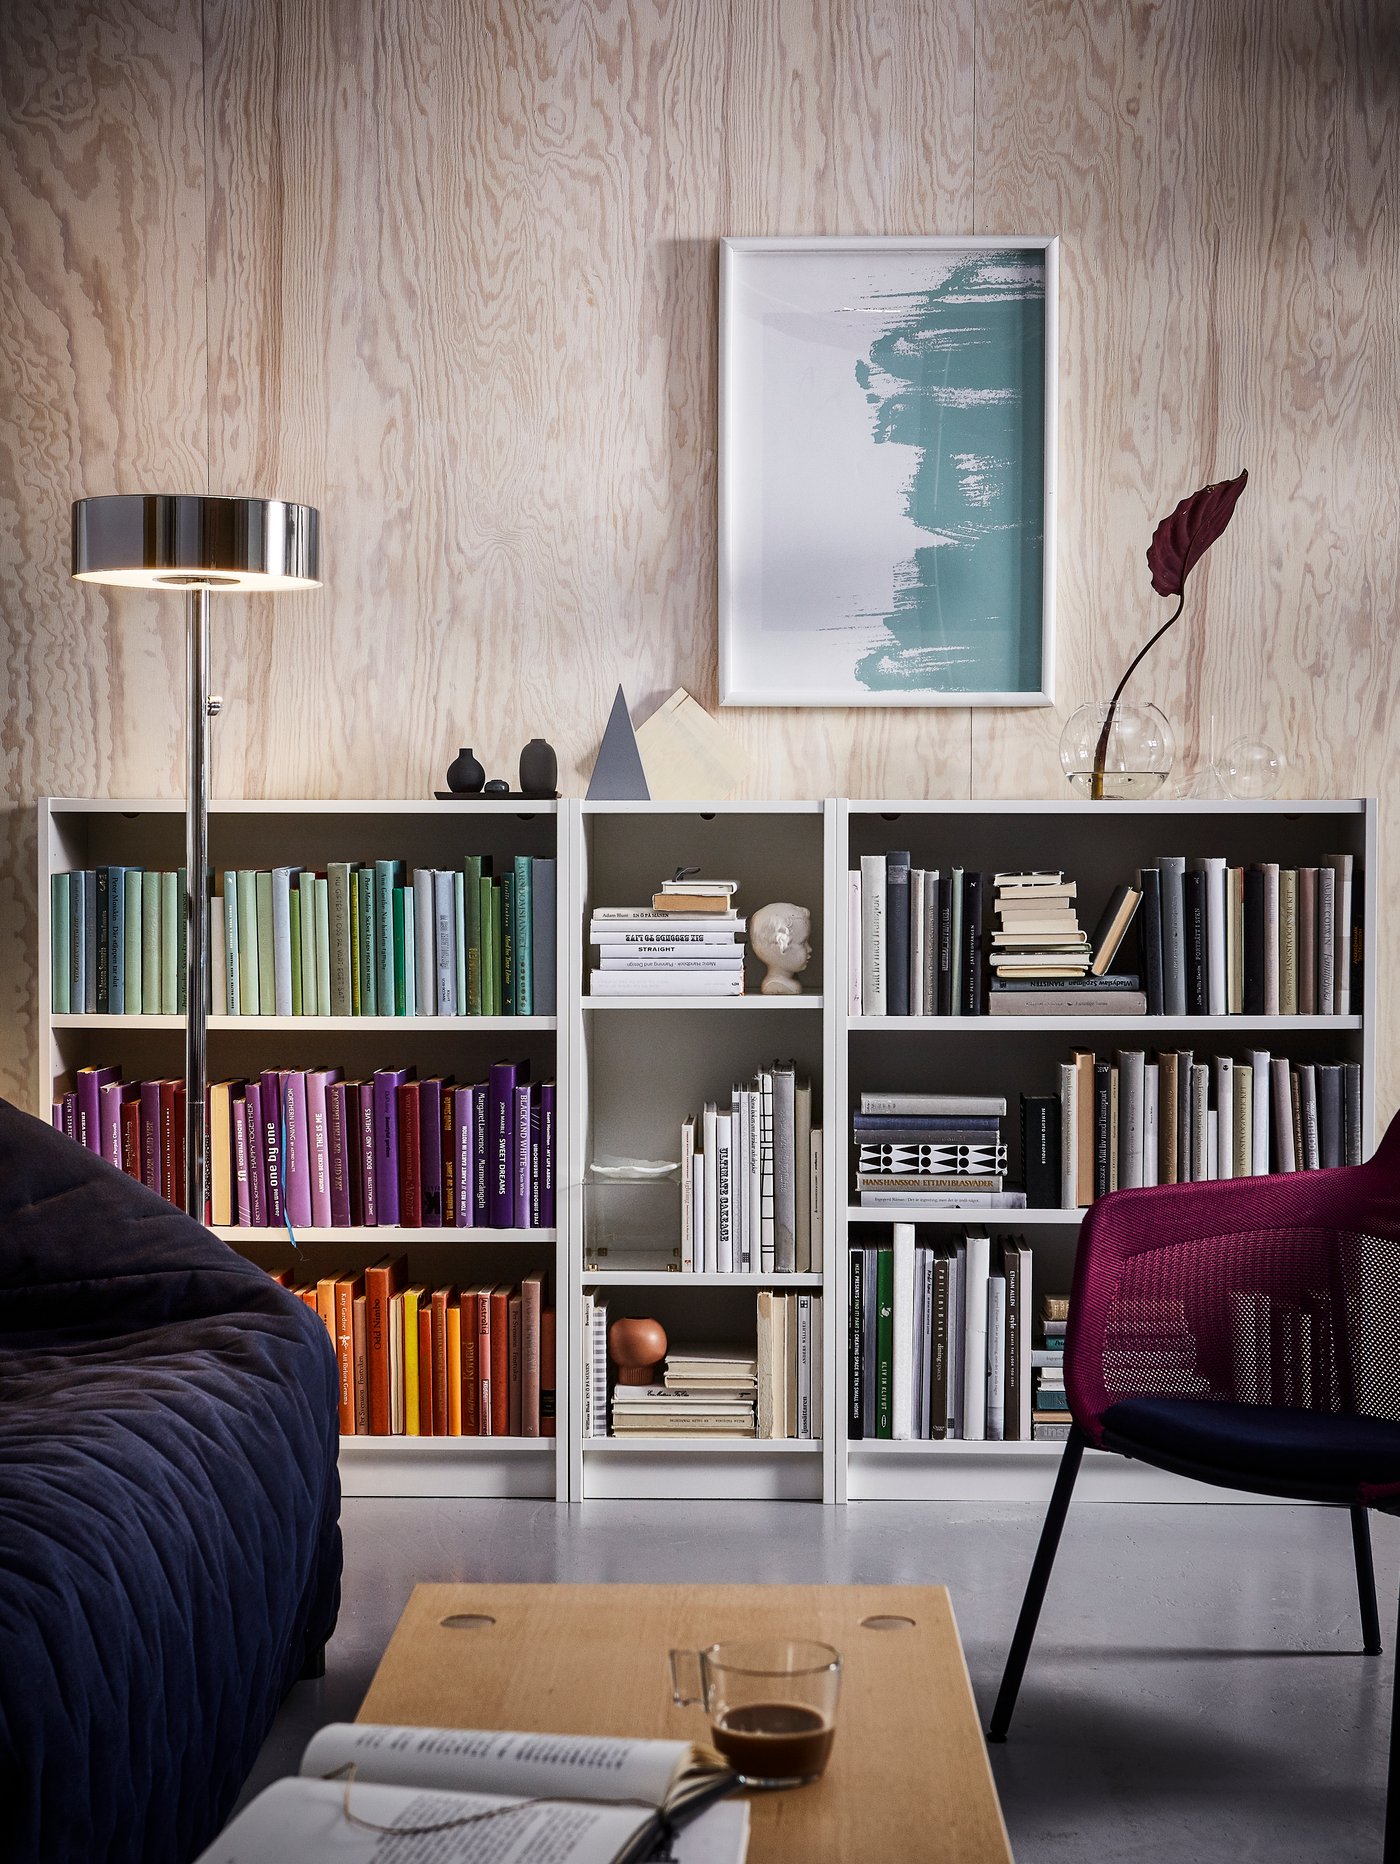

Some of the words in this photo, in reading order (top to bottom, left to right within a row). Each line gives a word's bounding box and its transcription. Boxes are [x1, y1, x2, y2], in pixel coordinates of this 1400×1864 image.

[625, 934, 644, 942] LIVE
[644, 934, 655, 942] TO
[655, 934, 689, 942] SECONDS
[691, 934, 704, 942] SIX
[1324, 911, 1332, 945] COLWIN
[110, 941, 119, 964] stäppen
[331, 1089, 339, 1120] JOSEPH
[476, 1092, 486, 1122] Margaret
[520, 1095, 528, 1120] BLACK
[1098, 1090, 1109, 1122] Transport
[247, 1103, 255, 1143] TOGETHER
[315, 1113, 323, 1123] ME
[364, 1108, 372, 1133] SHELVES
[520, 1121, 528, 1138] AND
[266, 1122, 275, 1145] one
[1098, 1123, 1107, 1138] med
[267, 1148, 279, 1162] by
[546, 1149, 551, 1157] MY
[1098, 1139, 1107, 1149] liv
[249, 1145, 257, 1169] HAPPY
[1098, 1149, 1107, 1164] Mitt
[238, 1169, 247, 1181] US
[269, 1165, 278, 1187] one
[445, 1161, 453, 1178] Janet
[498, 1164, 506, 1195] DREAMS
[719, 1148, 729, 1195] ULTIMATE
[477, 1158, 486, 1209] Marmorängeln
[684, 1180, 692, 1204] lighting
[937, 1269, 945, 1311] POTTERY
[373, 1299, 381, 1329] Nimbo
[480, 1298, 488, 1334] Australia
[373, 1331, 382, 1350] Odd
